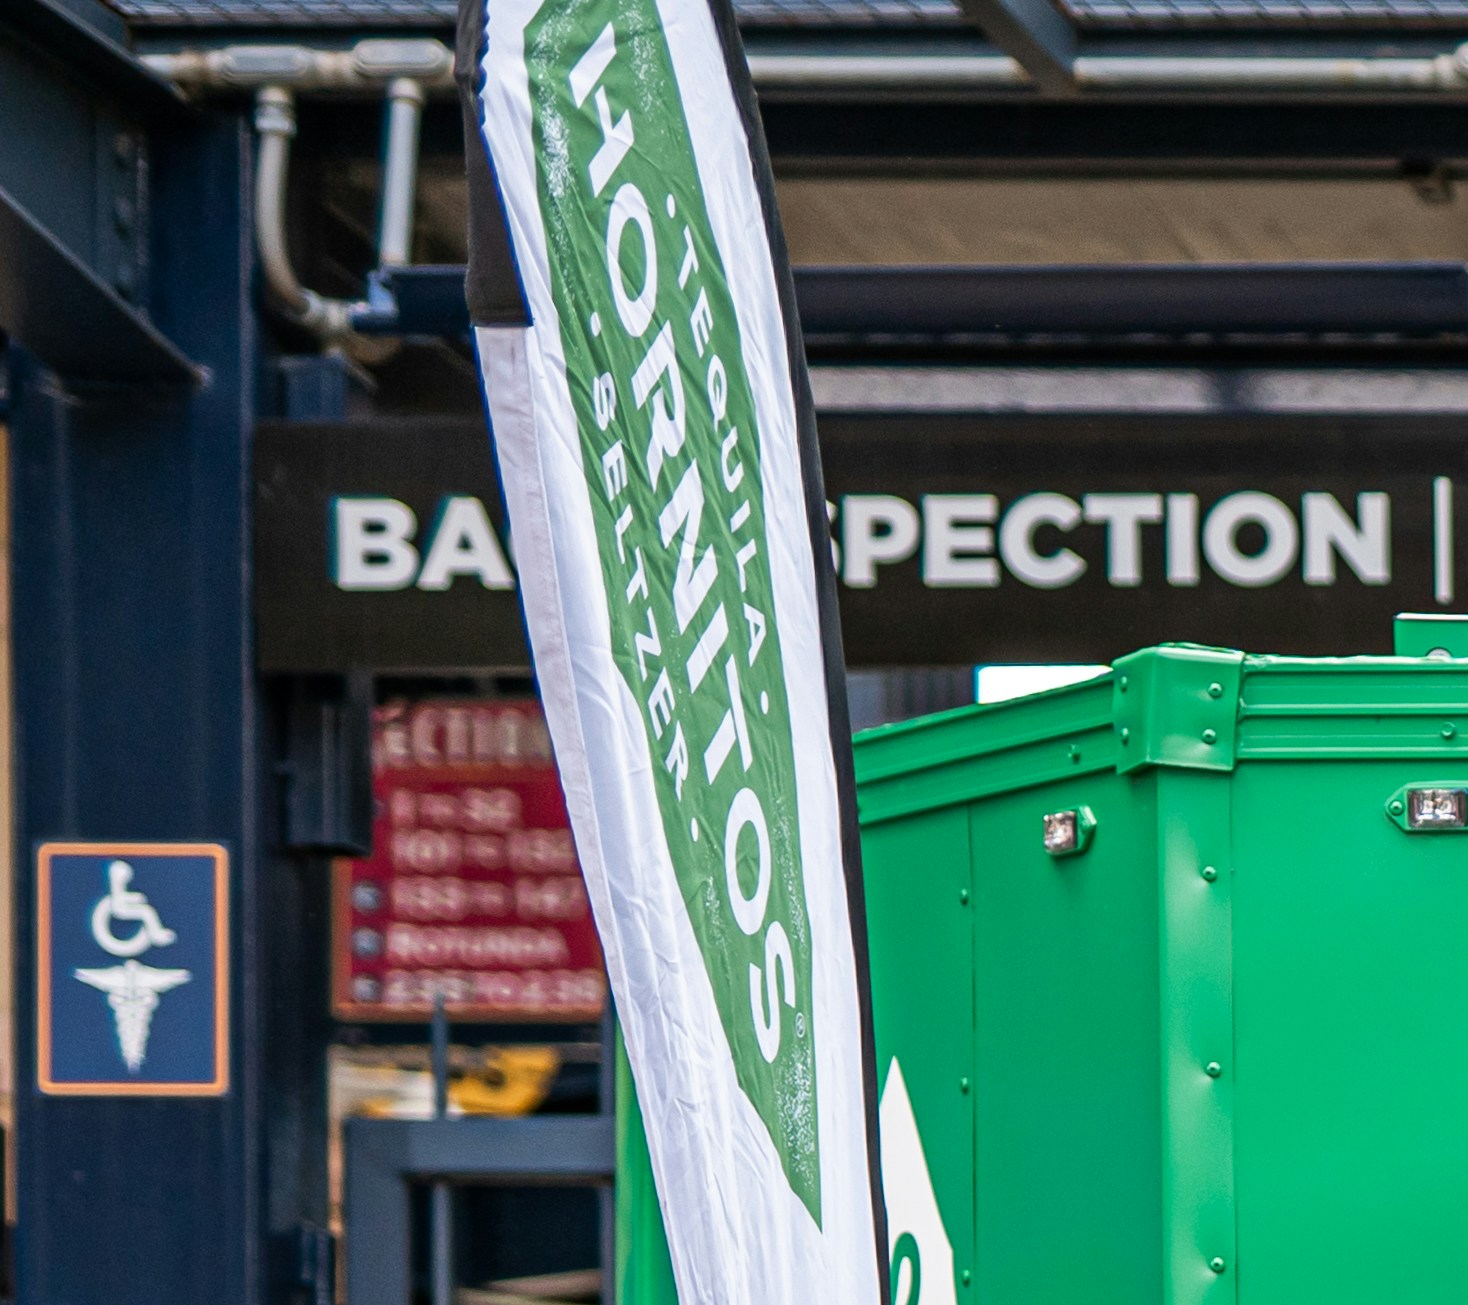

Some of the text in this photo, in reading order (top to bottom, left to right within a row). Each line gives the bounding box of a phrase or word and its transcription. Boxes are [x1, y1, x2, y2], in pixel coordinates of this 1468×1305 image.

[335, 495, 512, 591] BA
[826, 492, 1392, 591] PECTION
[592, 371, 690, 802] SELTZER
[677, 225, 766, 668] TEQUILA
